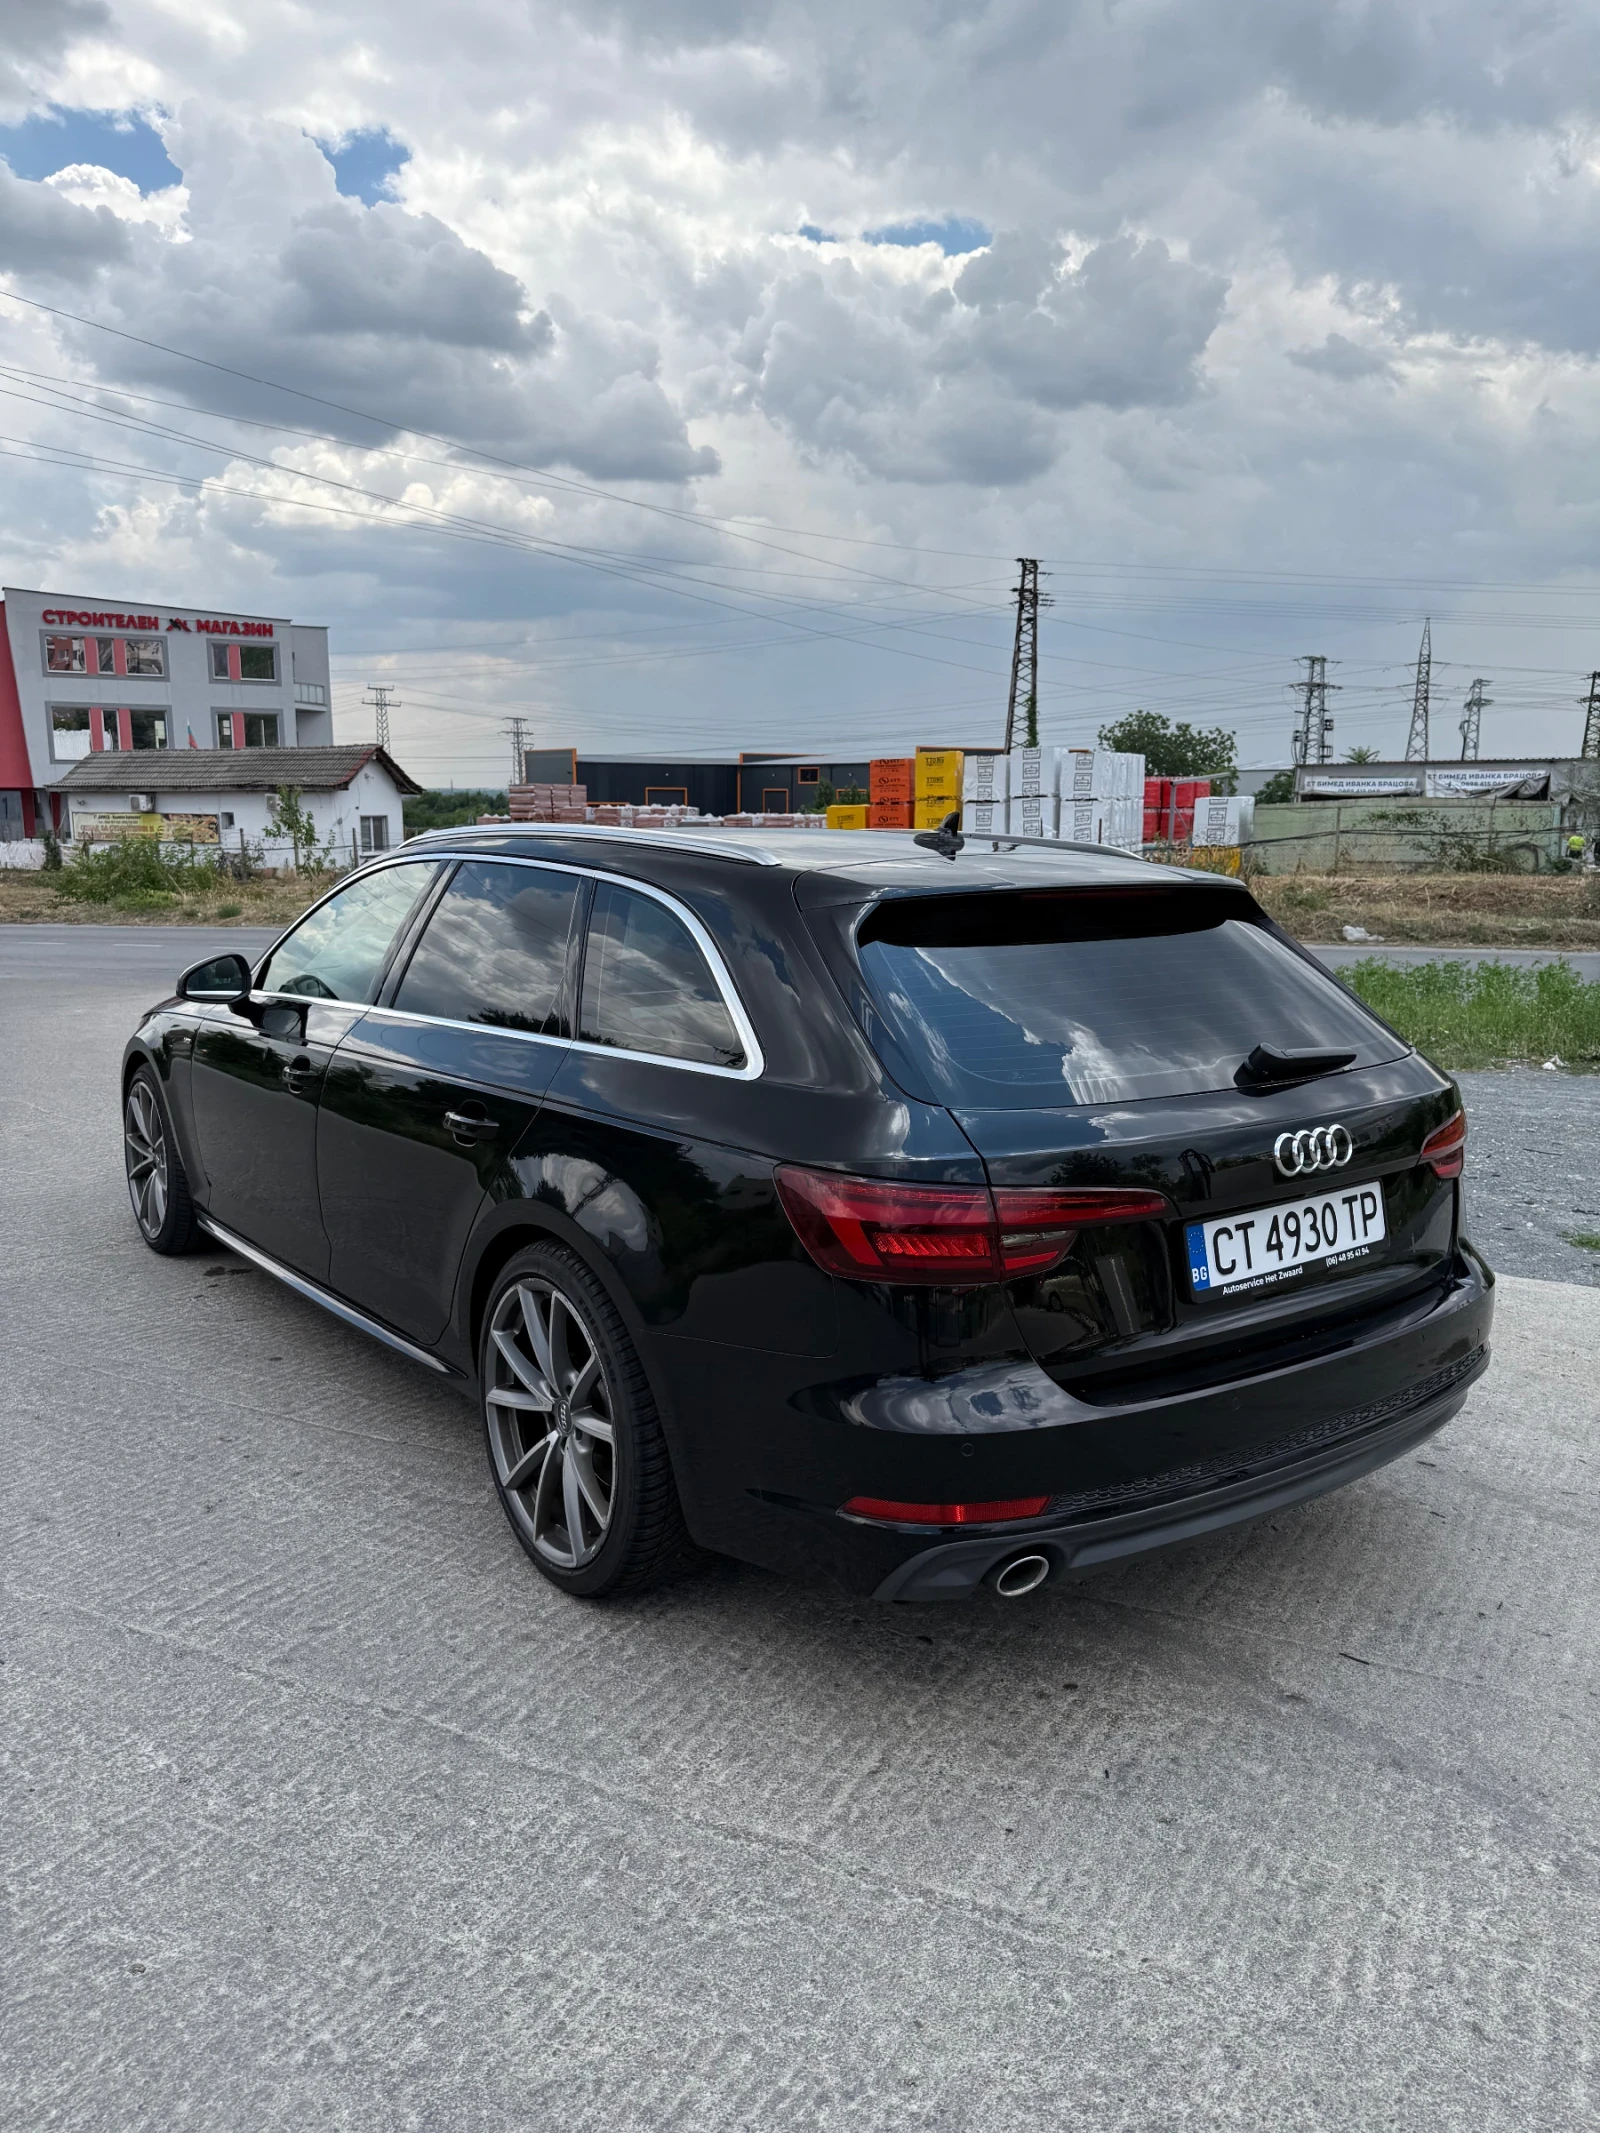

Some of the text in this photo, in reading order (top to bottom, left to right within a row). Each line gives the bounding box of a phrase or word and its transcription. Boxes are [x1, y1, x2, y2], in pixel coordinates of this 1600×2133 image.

[42, 609, 274, 637] СТРОИТЕЛЕН МАГАЗИН
[1212, 1191, 1378, 1276] CT 4930 TP
[1325, 1254, 1338, 1268] (06)
[1338, 1253, 1347, 1262] 48
[1191, 1267, 1208, 1283] BG
[1222, 1265, 1303, 1296] Autoservice Het Zwaard
